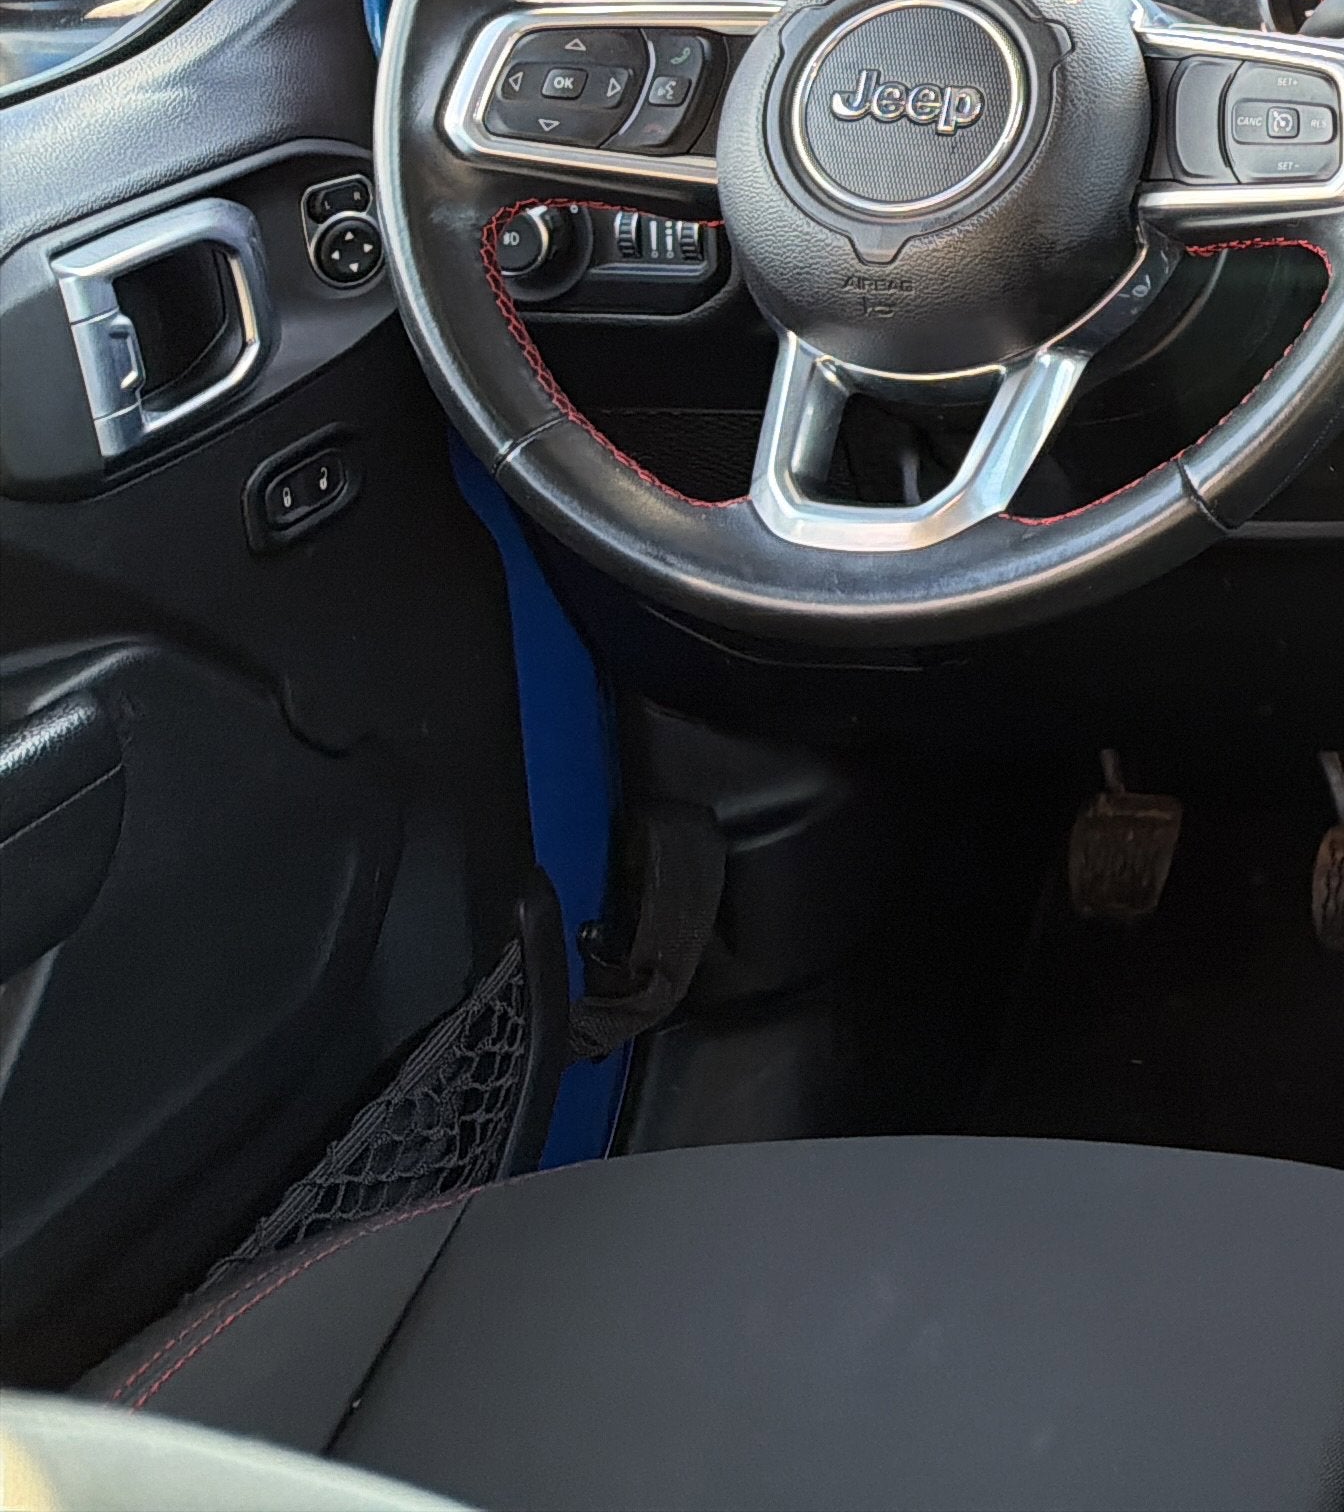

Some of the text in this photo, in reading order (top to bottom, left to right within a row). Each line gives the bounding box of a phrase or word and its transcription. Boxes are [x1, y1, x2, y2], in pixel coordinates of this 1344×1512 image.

[554, 77, 574, 89] OK
[831, 69, 985, 135] Jeep
[1237, 117, 1262, 126] CANC
